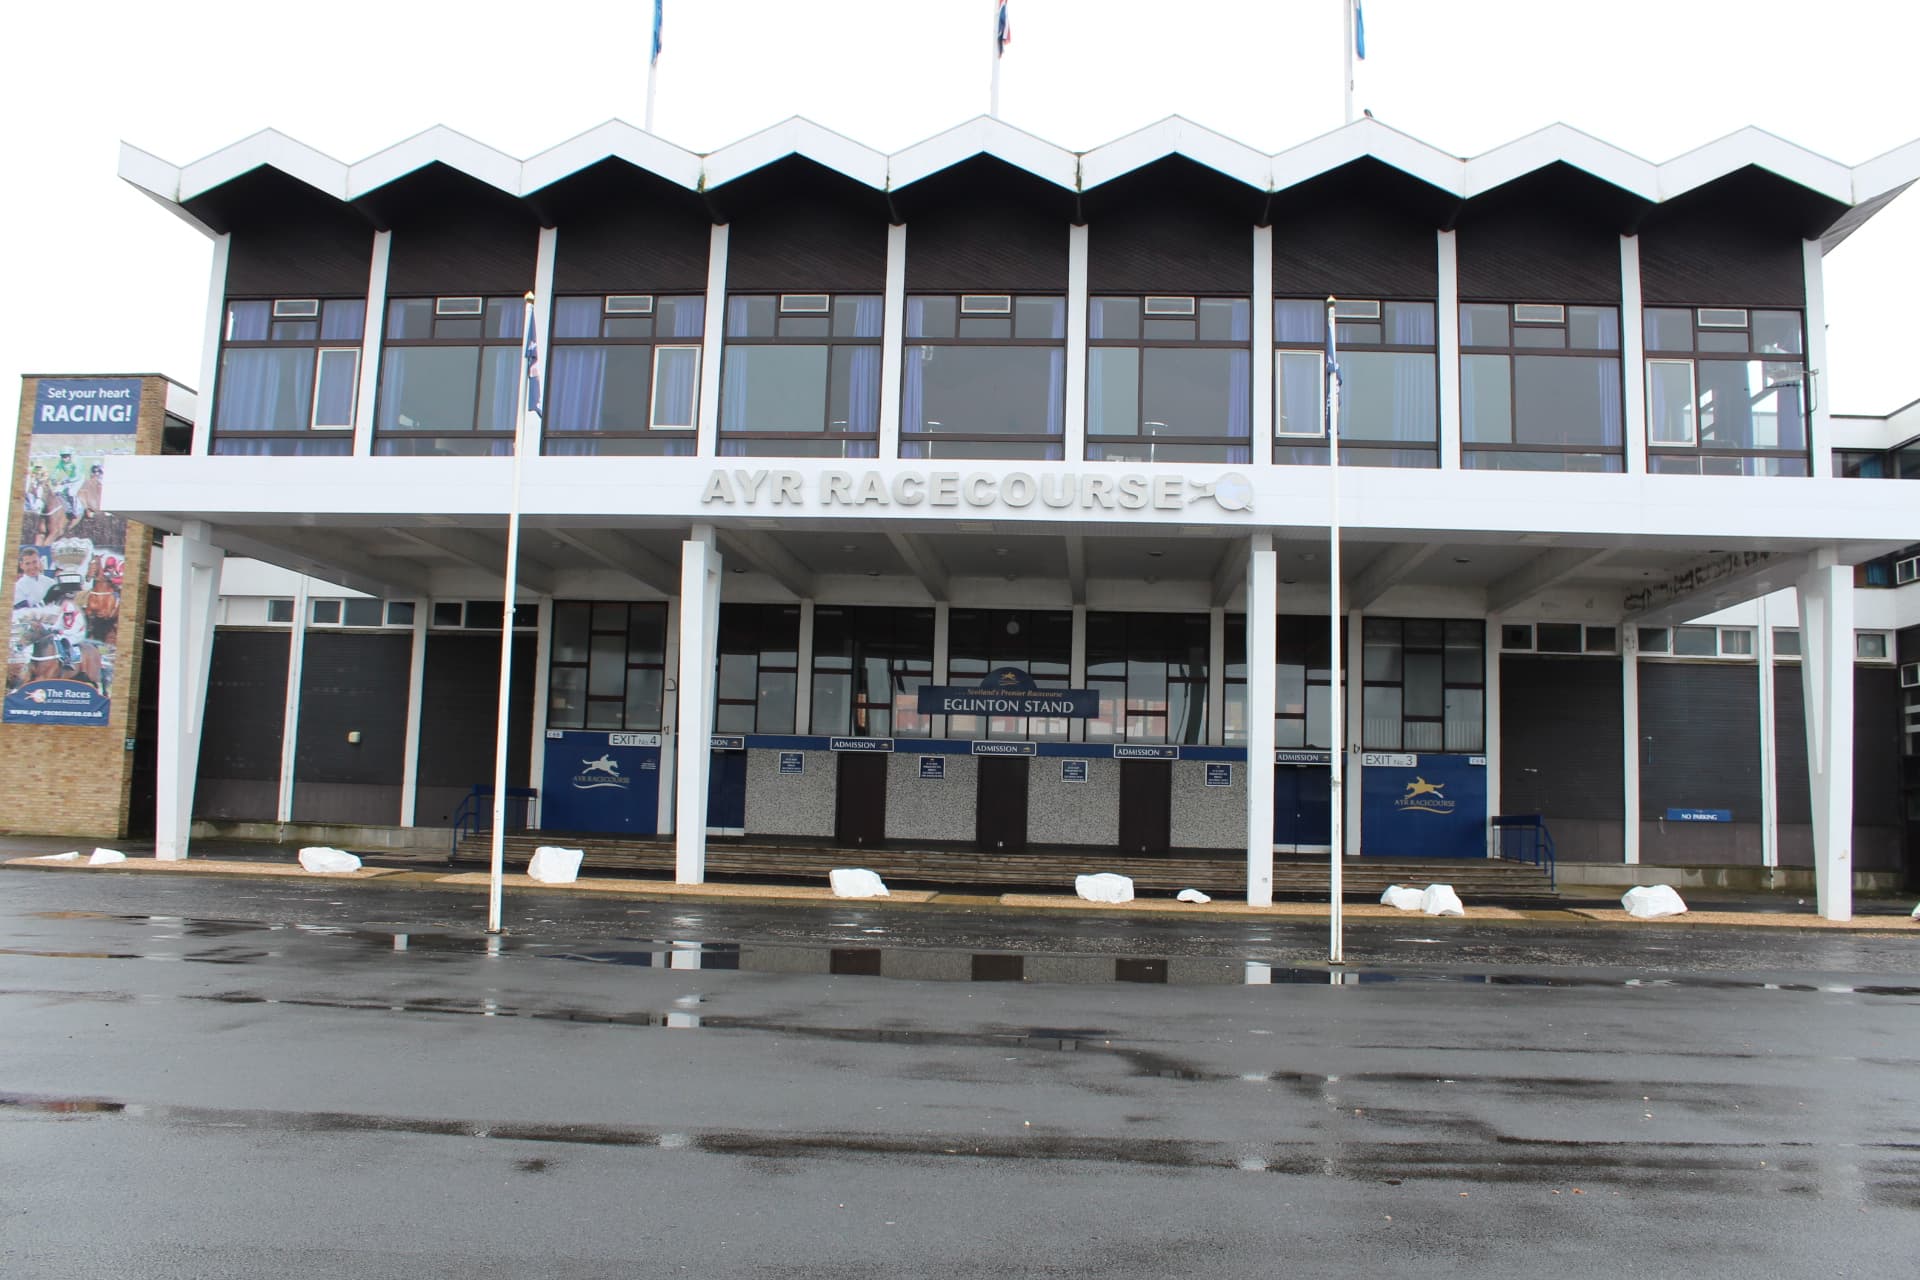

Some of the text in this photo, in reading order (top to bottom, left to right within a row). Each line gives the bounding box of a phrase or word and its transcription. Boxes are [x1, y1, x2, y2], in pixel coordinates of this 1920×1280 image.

[47, 388, 130, 401] Set your heart
[41, 404, 132, 422] RACING!
[702, 469, 1185, 510] AYR RACECOURSE
[46, 689, 91, 699] The Races
[943, 698, 1075, 714] EGLINTON STAND
[8, 709, 103, 718] www.ayr-racecourse.co.uk
[612, 734, 638, 745] EXIT
[650, 735, 657, 746] 4
[834, 741, 876, 749] ADMISSION
[975, 745, 1018, 753] ADMISSION
[1117, 748, 1160, 757] ADMISSION
[1277, 753, 1319, 762] ADMISSION
[1365, 755, 1391, 766] EXIT
[1405, 755, 1414, 767] 3
